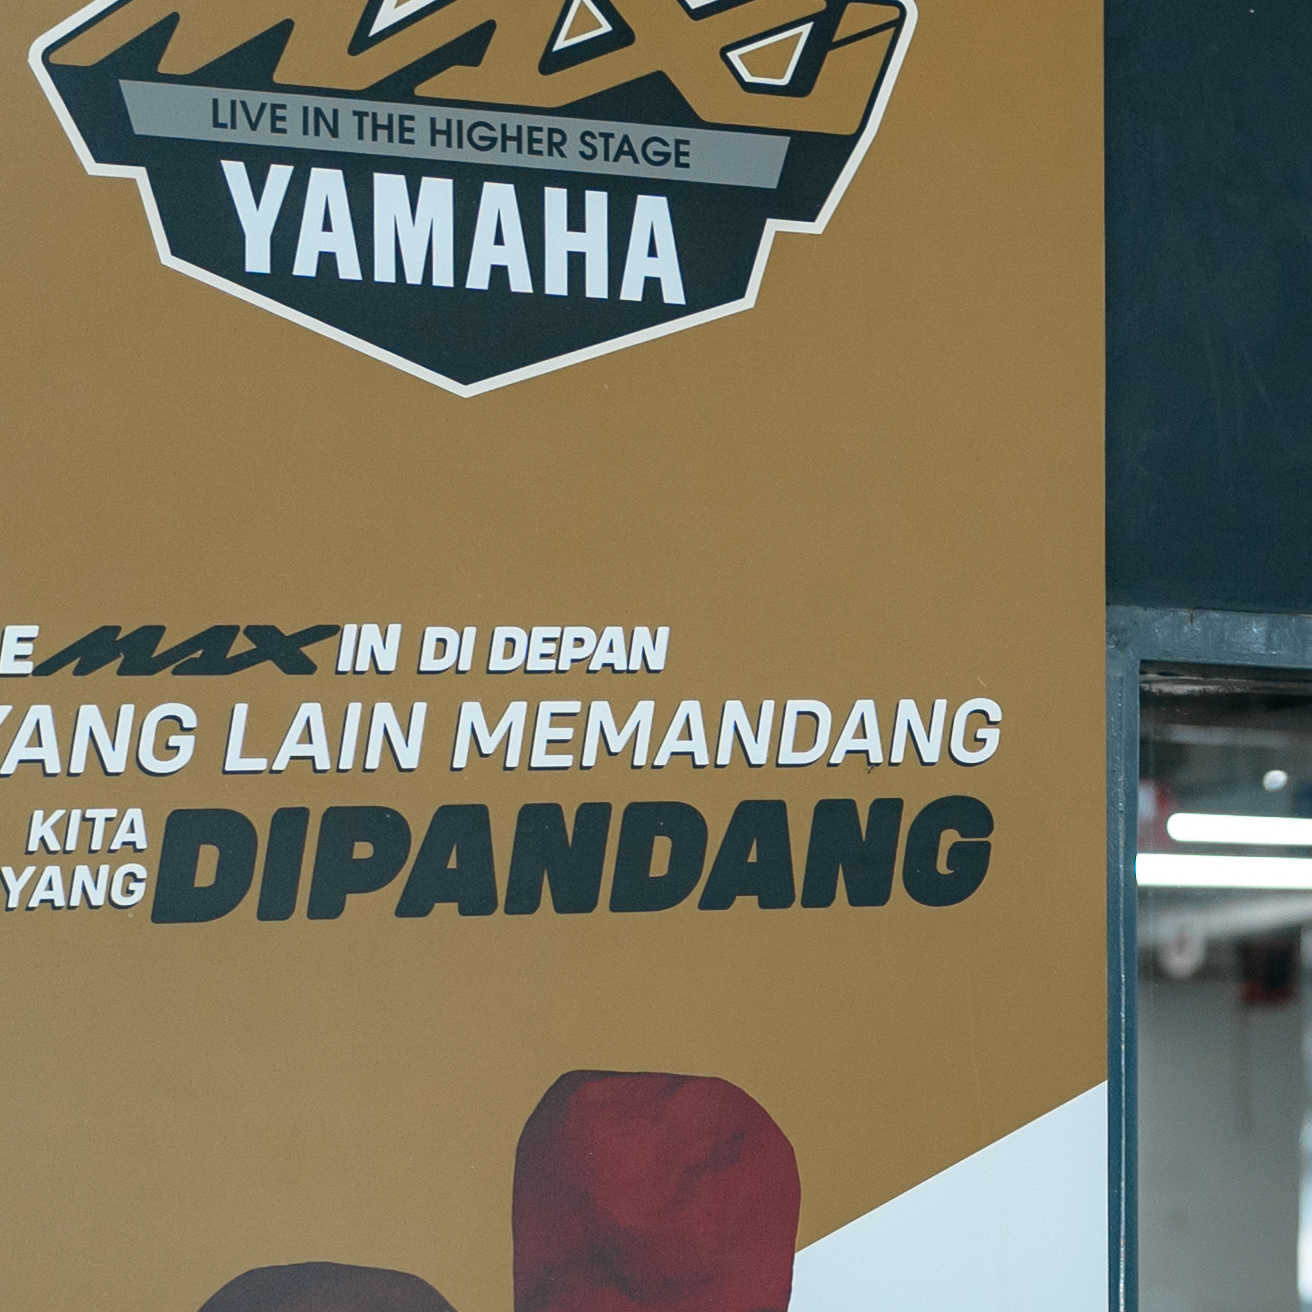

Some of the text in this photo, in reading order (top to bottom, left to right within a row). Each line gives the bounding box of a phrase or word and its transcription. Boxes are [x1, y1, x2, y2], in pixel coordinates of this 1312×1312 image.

[211, 97, 691, 169] LIVE IN THE HIGHER STAGE
[220, 159, 687, 306] YAMAHA
[417, 626, 477, 674] DI
[486, 626, 670, 674] DEPAN
[0, 698, 1003, 778] ANG LAIN MEMANDANG
[25, 807, 148, 854] KITA
[150, 795, 995, 925] DIPANDANG
[0, 863, 148, 911] YANG
